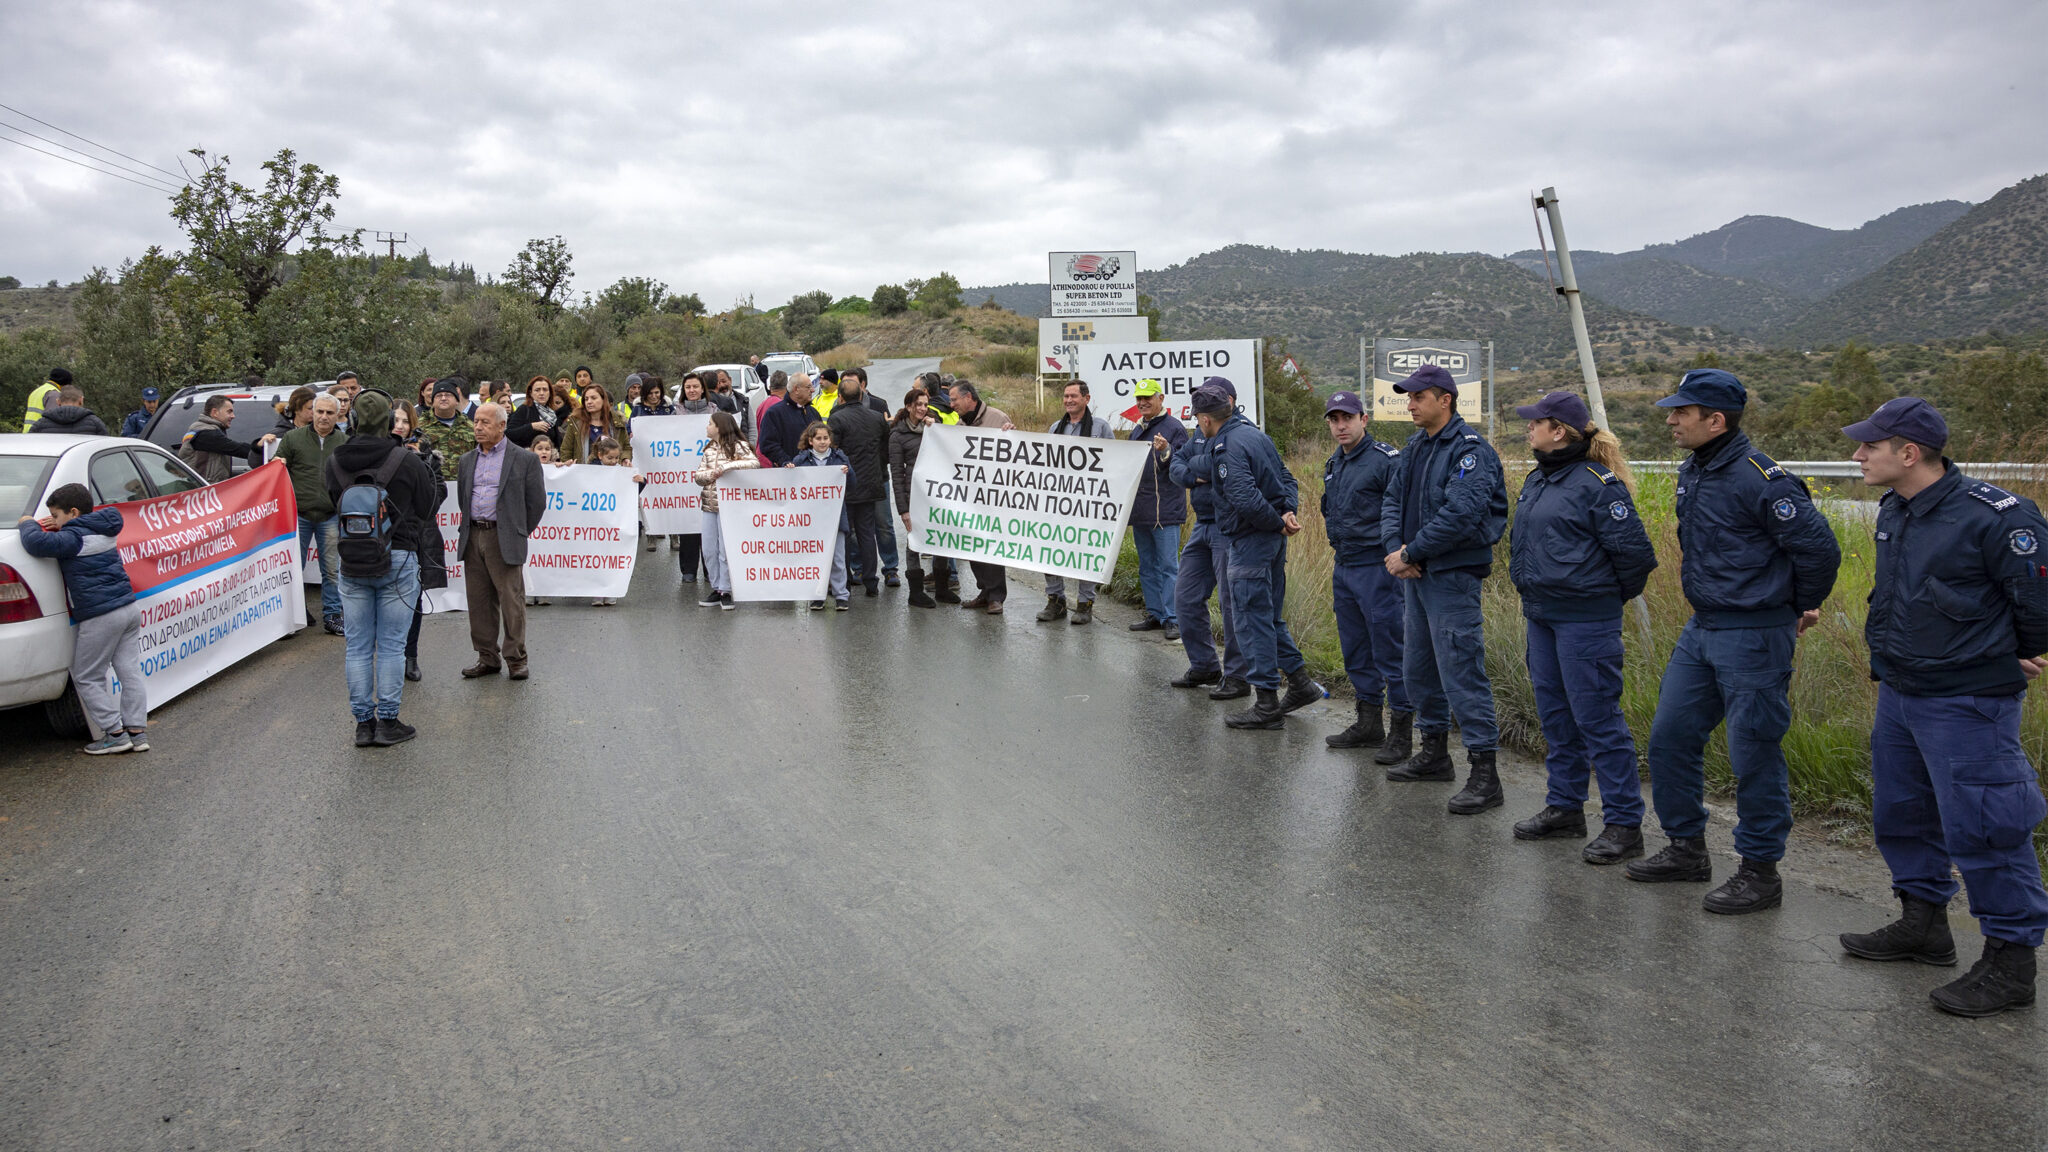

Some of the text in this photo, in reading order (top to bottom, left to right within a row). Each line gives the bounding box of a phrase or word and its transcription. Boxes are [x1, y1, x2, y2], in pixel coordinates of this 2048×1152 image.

[1101, 350, 1230, 371] ΛΑΤΟΜΕΙΟ
[1393, 354, 1464, 369] ZEMCO
[649, 440, 681, 458] 1975
[963, 435, 1104, 473] ΣΕΒΑΣΜΟΣ
[646, 471, 688, 485] ΠΟΣΟΥΣ
[952, 463, 1111, 498] ΣΤΑ ΔΙΚΑΙΩΜΑΤΑ
[581, 492, 616, 512] 2020
[720, 485, 843, 501] THE HEALTH & SAFETY
[925, 479, 968, 502] ΤΩΝ
[973, 487, 1039, 511] ΑΠΛΩΝ
[138, 486, 223, 532] 1975-2020
[752, 513, 811, 528] OF US AND
[138, 524, 209, 559] ΚΑΤΑΣΤΡΟΦΗΣ
[206, 518, 226, 536] ΤΗΣ
[225, 498, 279, 530] ΠΑΡΕΚΚΛΗΣΙΑΣ
[573, 527, 620, 541] ΡΥΠΟΥΣ
[928, 506, 1114, 549] ΚΙΝΗΜΑ ΟΙΚΟΛΟΓΩΝ
[156, 534, 238, 575] ΑΠΟ ΤΑ ΛΑΤΟΜΕΙΑ
[741, 539, 824, 555] OUR CHILDREN
[925, 528, 1034, 563] ΣΥΝΕΡΓΑΣΙΑ
[528, 553, 632, 570] ΑΝΑΠΝΕΥΣΟΥΜΕ?
[746, 566, 820, 581] IS IN DANGER
[184, 587, 206, 611] ΑΠΟ
[206, 580, 226, 601] ΤΙΣ
[222, 566, 256, 595] 8:00-12:00
[256, 558, 268, 575] ΤΟ
[159, 616, 200, 645] ΔΡΟΜΩΝ
[200, 608, 217, 629] ΑΠΟ
[218, 599, 232, 617] ΚΑΙ
[231, 590, 249, 611] ΠΡΟΣ
[249, 585, 260, 600] ΤΑ
[140, 647, 177, 677] ΟΥΣΙΑ
[179, 635, 207, 660] ΟΛΩΝ
[208, 621, 231, 646] ΕΙΝΑΙ
[231, 594, 283, 635] ΑΠΑΡΑΙΤΗΤΗ
